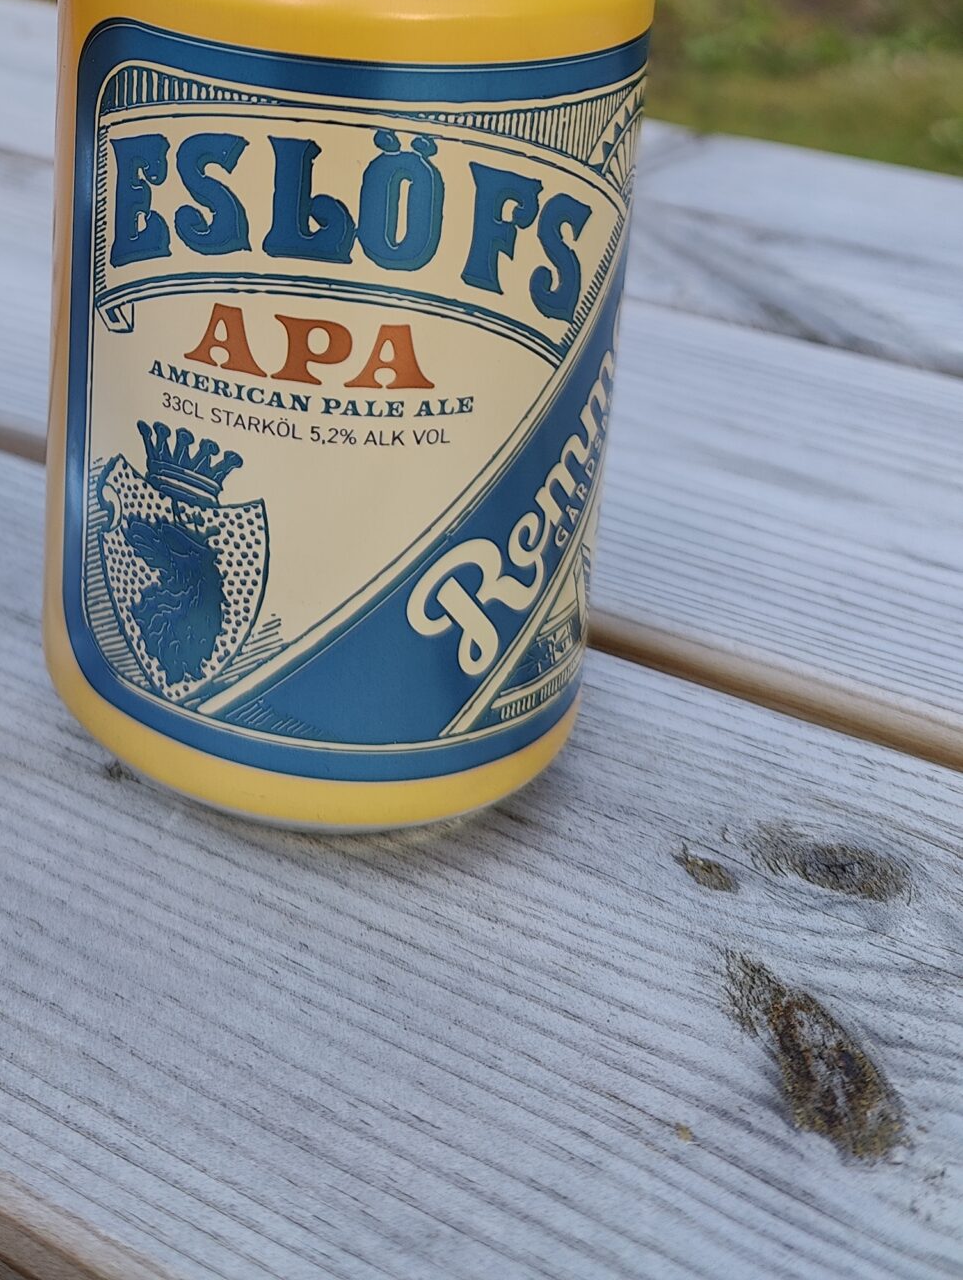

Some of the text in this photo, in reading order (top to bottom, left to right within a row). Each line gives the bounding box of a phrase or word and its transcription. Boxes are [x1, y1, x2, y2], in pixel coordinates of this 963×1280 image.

[109, 128, 593, 325] ESLÖFS
[148, 359, 475, 418] AMERICAN PALE ALE
[183, 302, 436, 390] APA
[161, 392, 451, 447] 33CL STARKÖL 5,2% ALK VOL
[406, 296, 622, 676] Remm
